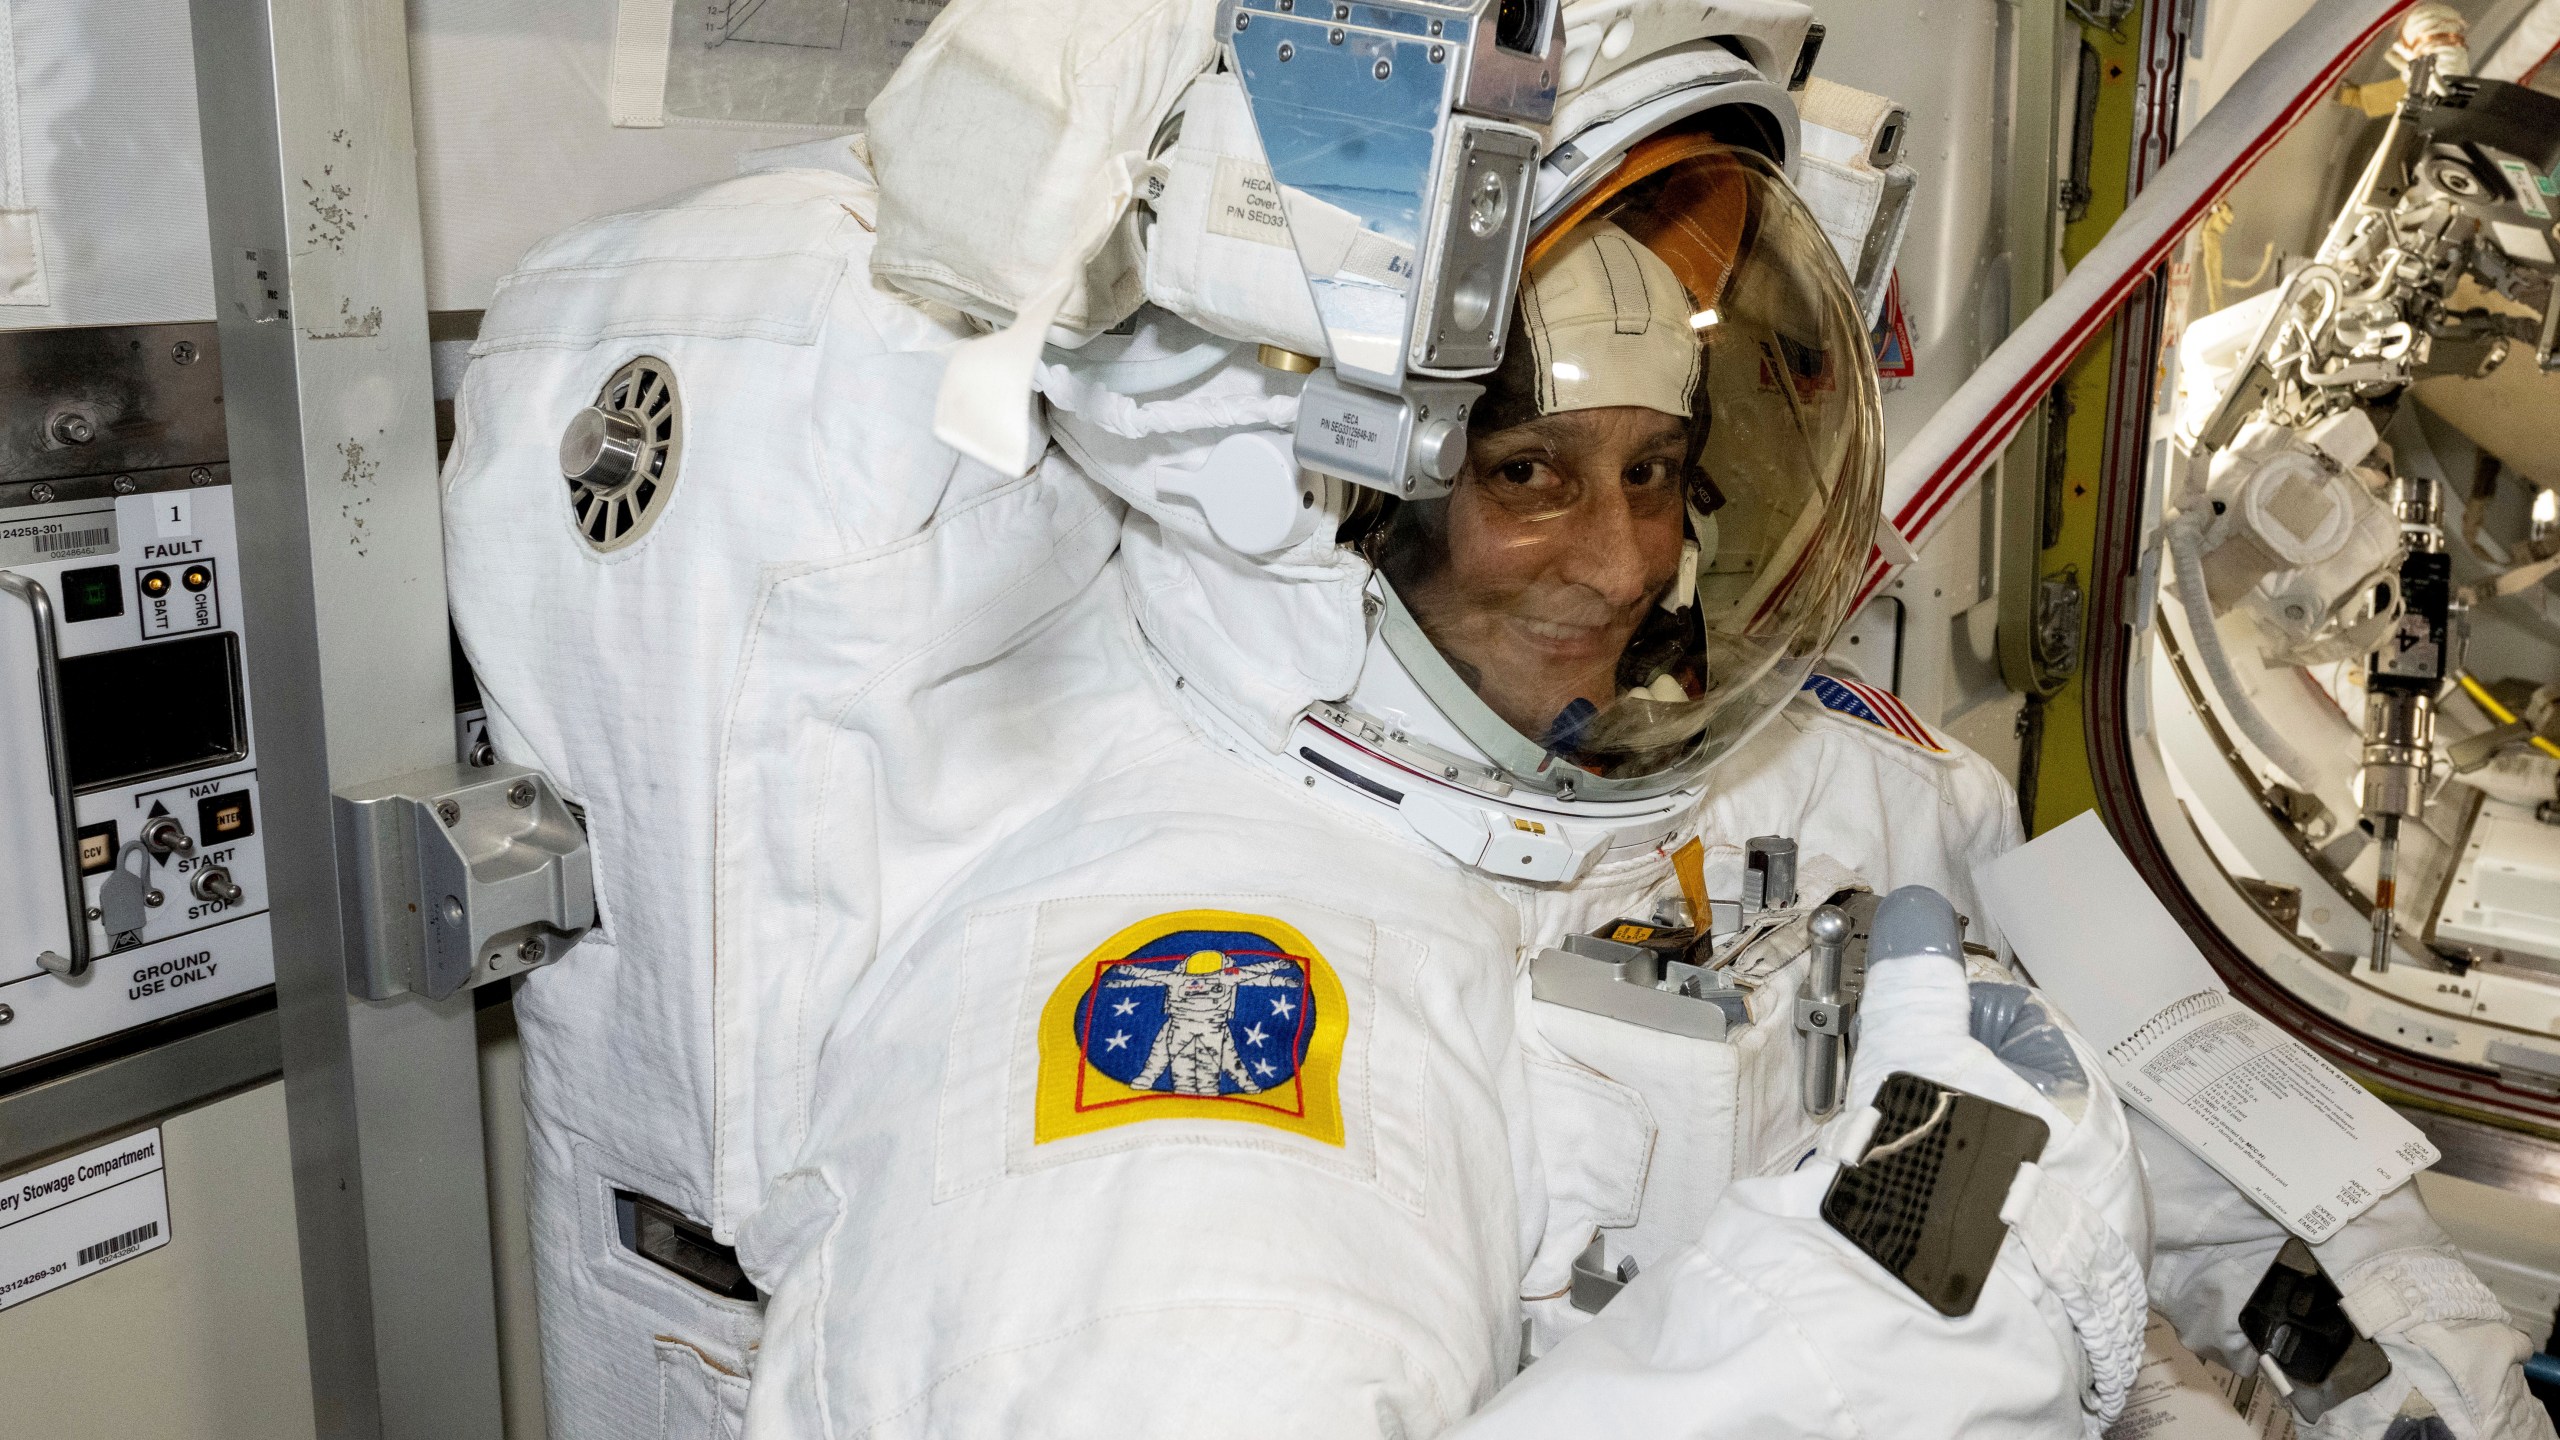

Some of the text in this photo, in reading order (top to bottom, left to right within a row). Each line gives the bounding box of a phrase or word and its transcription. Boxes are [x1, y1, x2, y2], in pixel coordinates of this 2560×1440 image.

[1242, 176, 1272, 193] HECA
[1246, 193, 1276, 210] Cover
[1226, 205, 1289, 228] P/N SED33
[1342, 411, 1359, 426] HECA
[171, 506, 181, 522] 1
[144, 540, 203, 559] FAULT
[154, 600, 169, 630] BATT
[194, 594, 209, 627] CHGR
[189, 781, 220, 798] NAV
[84, 846, 102, 859] CCV
[178, 848, 235, 873] START
[188, 898, 235, 920] STOP
[132, 950, 211, 984] GROUND
[128, 963, 218, 1001] USE ONLY
[2293, 1042, 2319, 1062] NORMAL
[2320, 1063, 2334, 1073] EVA
[2335, 1074, 2361, 1094] STATUS
[2131, 1086, 2145, 1096] NOV
[2143, 1094, 2152, 1102] 22
[2197, 1094, 2218, 1111] COMBO
[2217, 1129, 2234, 1142] during
[2233, 1141, 2244, 1149] and
[2413, 1142, 2428, 1153] DCM
[2395, 1150, 2415, 1165] INDEX
[0, 1142, 156, 1212] ery Stowage Compartment
[2340, 1189, 2358, 1203] TERM
[2347, 1186, 2362, 1197] EVA
[2349, 1179, 2371, 1196] ABORT
[2336, 1194, 2350, 1205] EVA
[2315, 1204, 2337, 1221] EXPED
[2297, 1218, 2318, 1234] EMER
